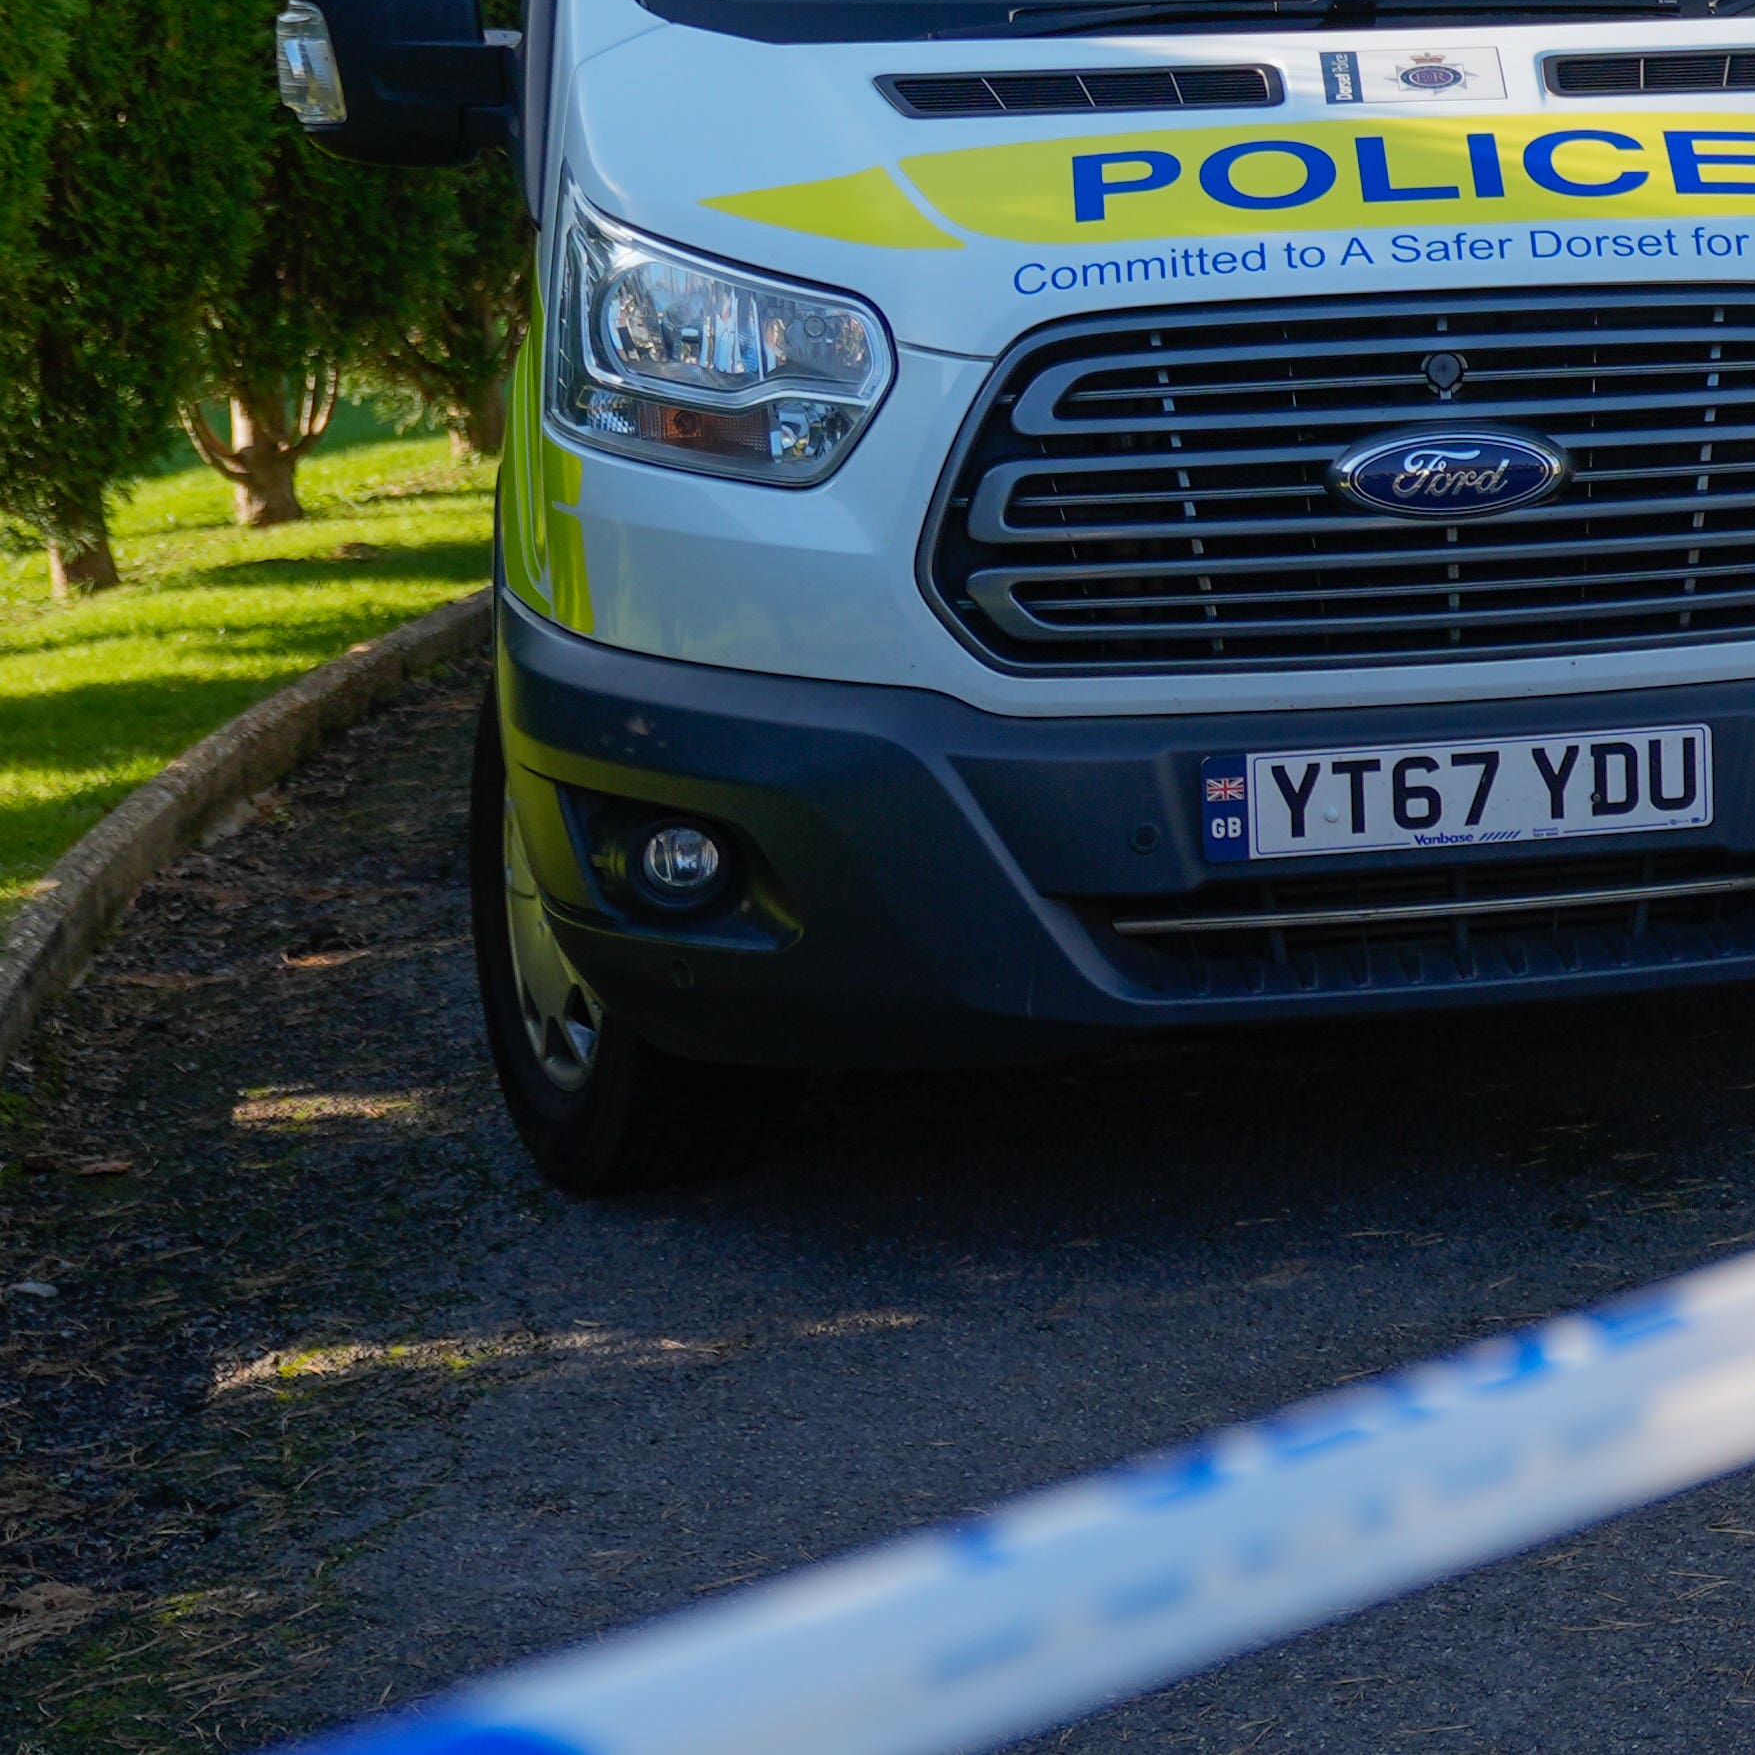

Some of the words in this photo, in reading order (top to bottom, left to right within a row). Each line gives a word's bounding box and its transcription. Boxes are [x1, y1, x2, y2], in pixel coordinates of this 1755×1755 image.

[1013, 242, 1267, 295] Committed
[1283, 242, 1326, 270] to
[1340, 237, 1375, 266] A
[1391, 232, 1513, 264] Safer
[1529, 228, 1679, 259] Dorset
[1690, 226, 1750, 257] for
[1392, 449, 1511, 498] Ford
[1270, 751, 1501, 838] YT67
[1531, 737, 1698, 820] YDU
[1211, 817, 1242, 839] GB
[1413, 831, 1474, 846] Vanbase
